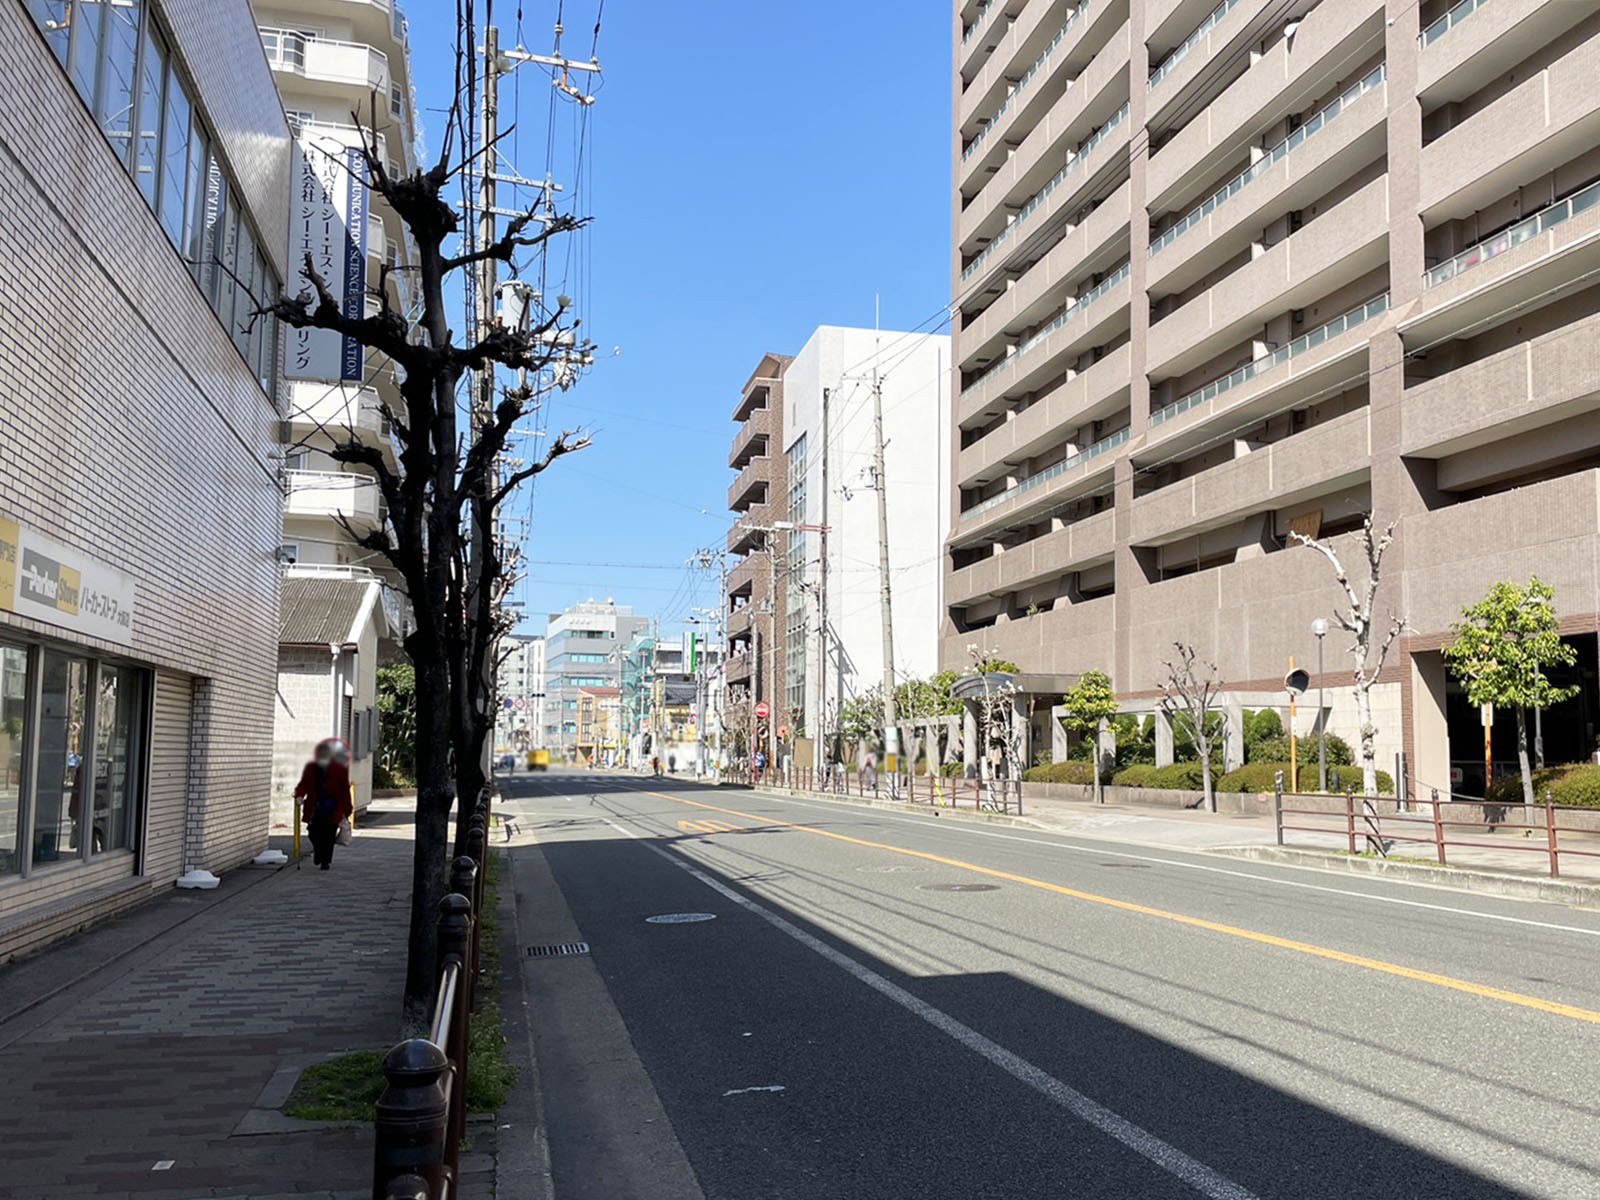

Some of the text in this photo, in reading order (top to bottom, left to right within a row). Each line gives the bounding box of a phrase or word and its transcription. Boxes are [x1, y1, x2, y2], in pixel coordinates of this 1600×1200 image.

[301, 149, 317, 203] 株式会社
[346, 152, 364, 377] COMMUNICATION SCIENCE CORRATION
[24, 564, 58, 599] Parker
